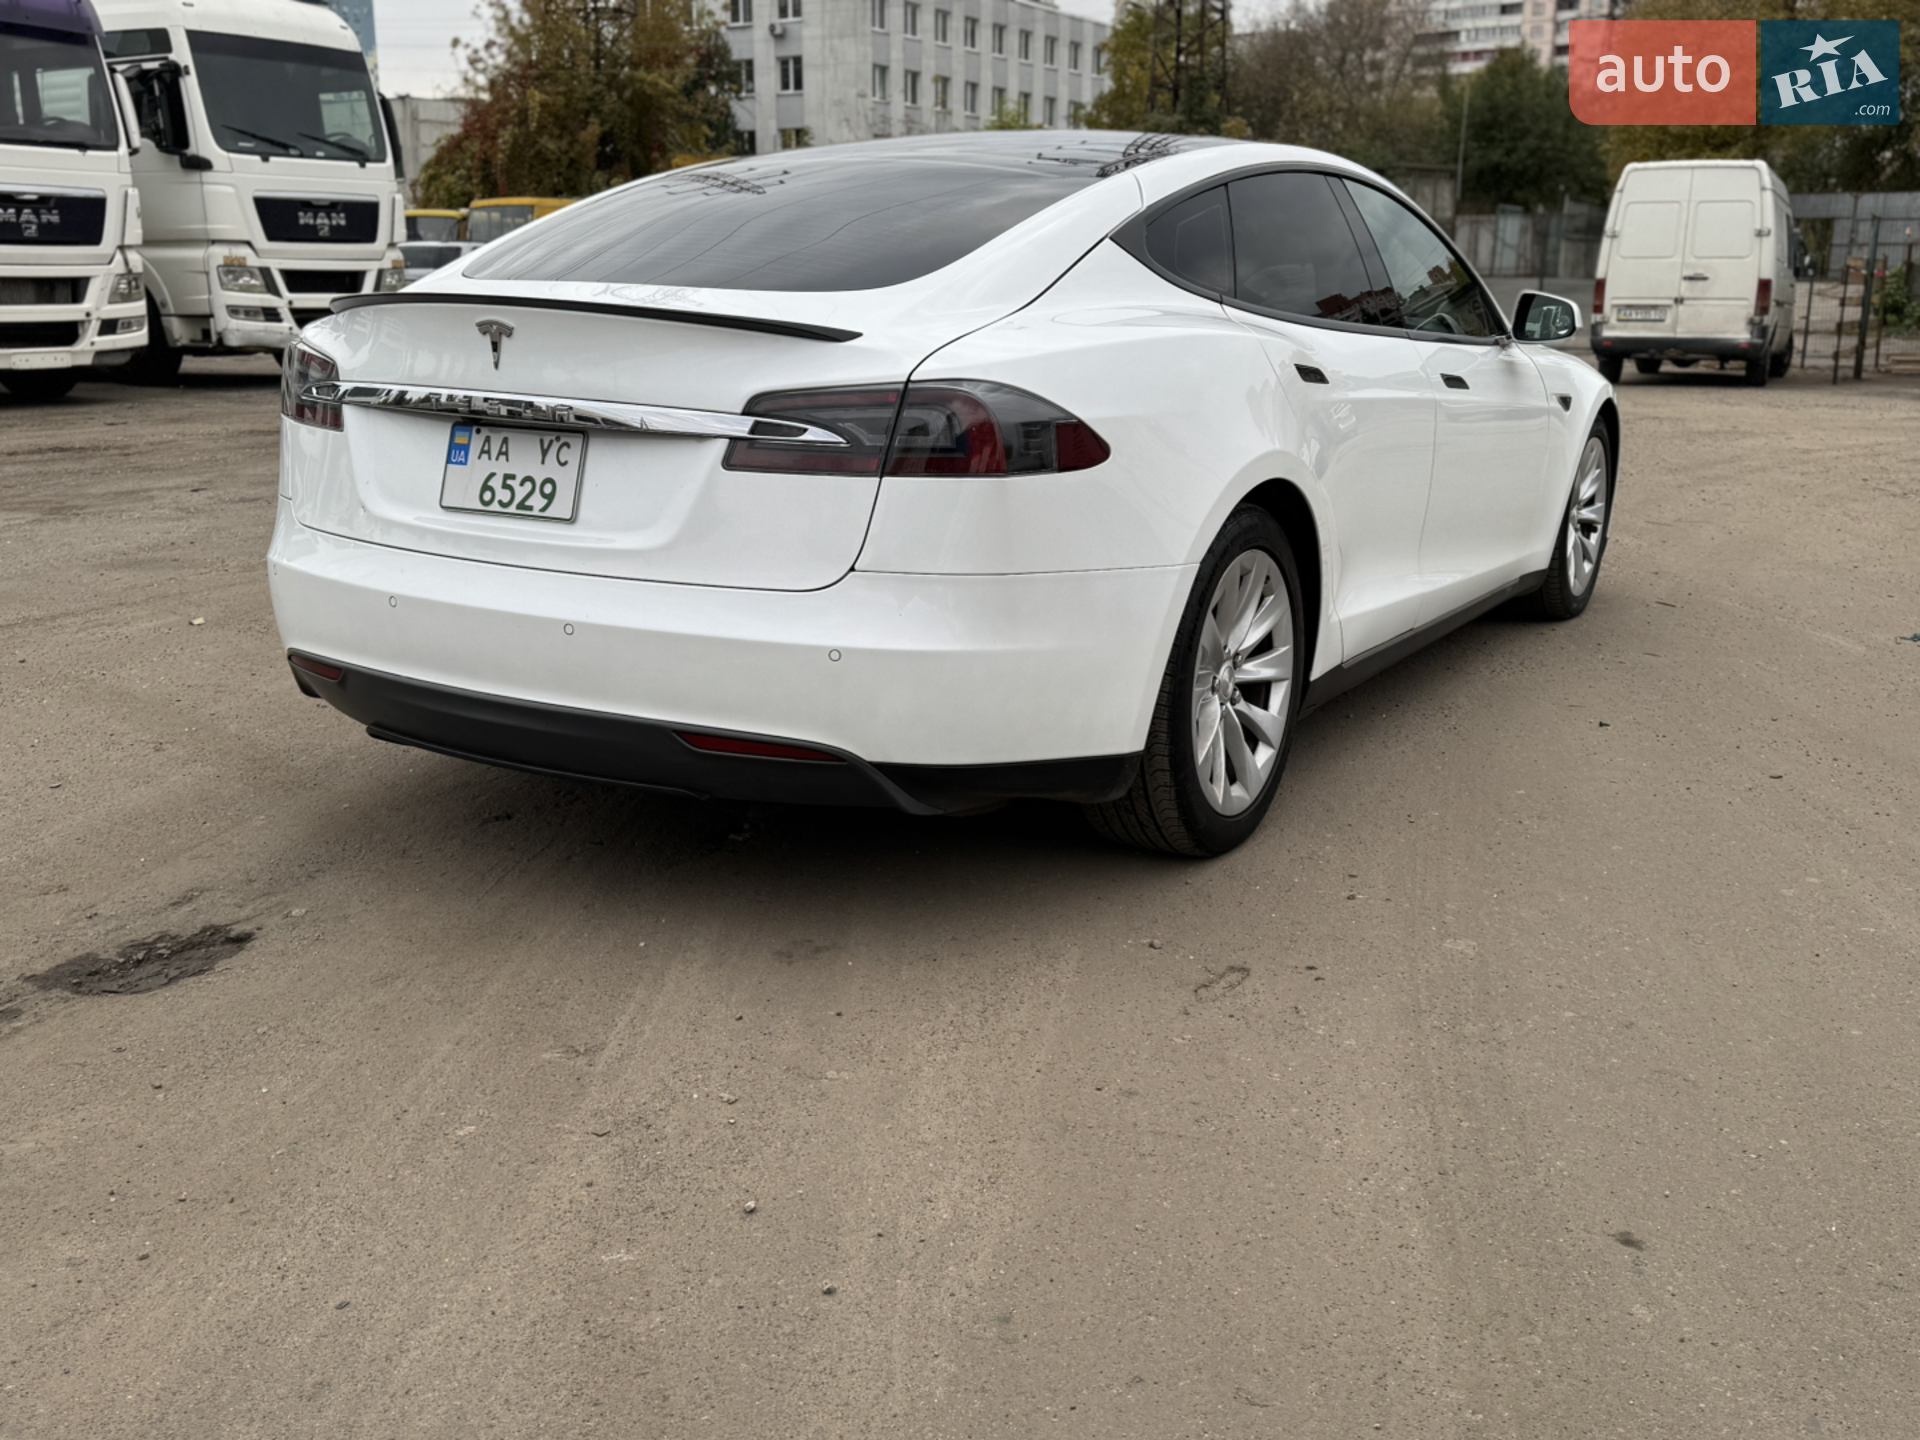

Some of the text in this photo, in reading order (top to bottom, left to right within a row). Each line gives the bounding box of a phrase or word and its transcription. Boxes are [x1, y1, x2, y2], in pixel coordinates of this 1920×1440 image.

[298, 212, 346, 226] MAN
[451, 449, 466, 464] UA
[477, 435, 571, 467] AA YC
[478, 472, 557, 513] 6529
